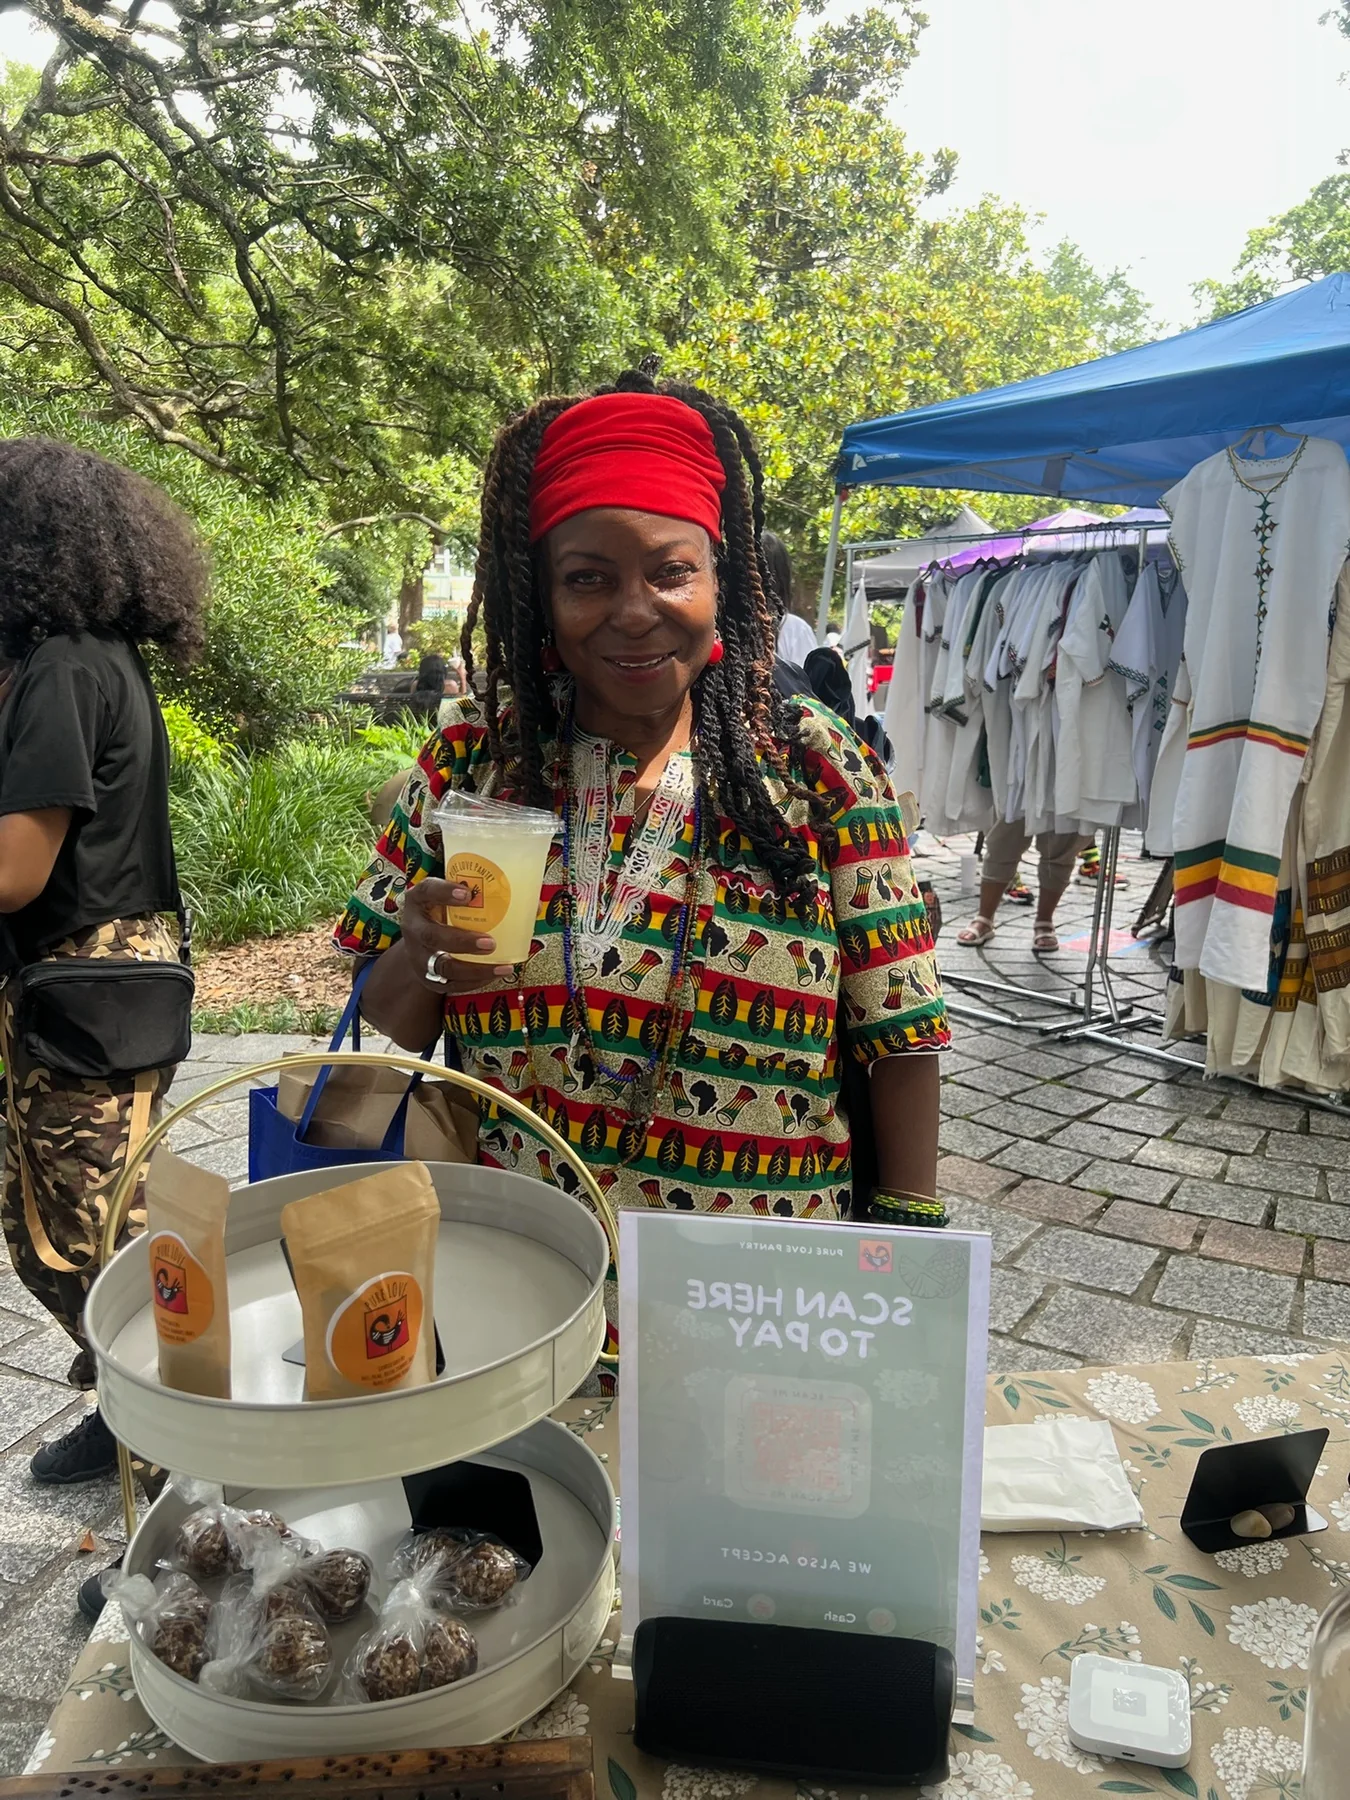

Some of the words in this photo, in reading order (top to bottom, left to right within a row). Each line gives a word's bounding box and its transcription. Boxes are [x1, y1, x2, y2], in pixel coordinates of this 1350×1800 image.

[459, 861, 473, 871] LOVE
[474, 862, 495, 883] PANTRY
[364, 1288, 386, 1312] PURE
